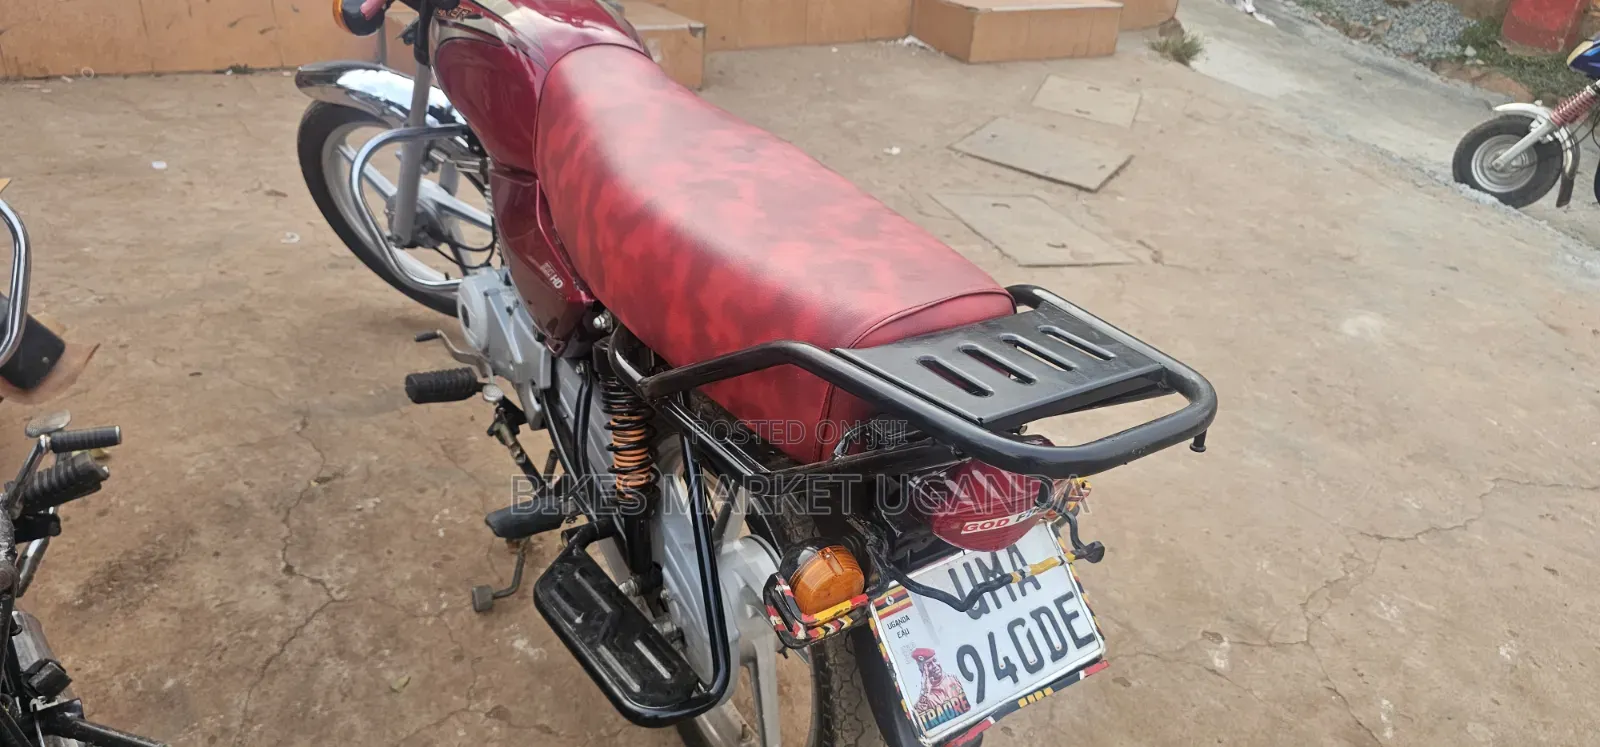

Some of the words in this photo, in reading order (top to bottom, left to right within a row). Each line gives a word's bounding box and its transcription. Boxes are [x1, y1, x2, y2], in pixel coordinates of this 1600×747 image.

[550, 274, 563, 288] HD
[963, 518, 1010, 532] GOD
[948, 544, 1041, 620] UMA
[887, 615, 911, 630] UGANDA
[896, 628, 910, 639] EAU
